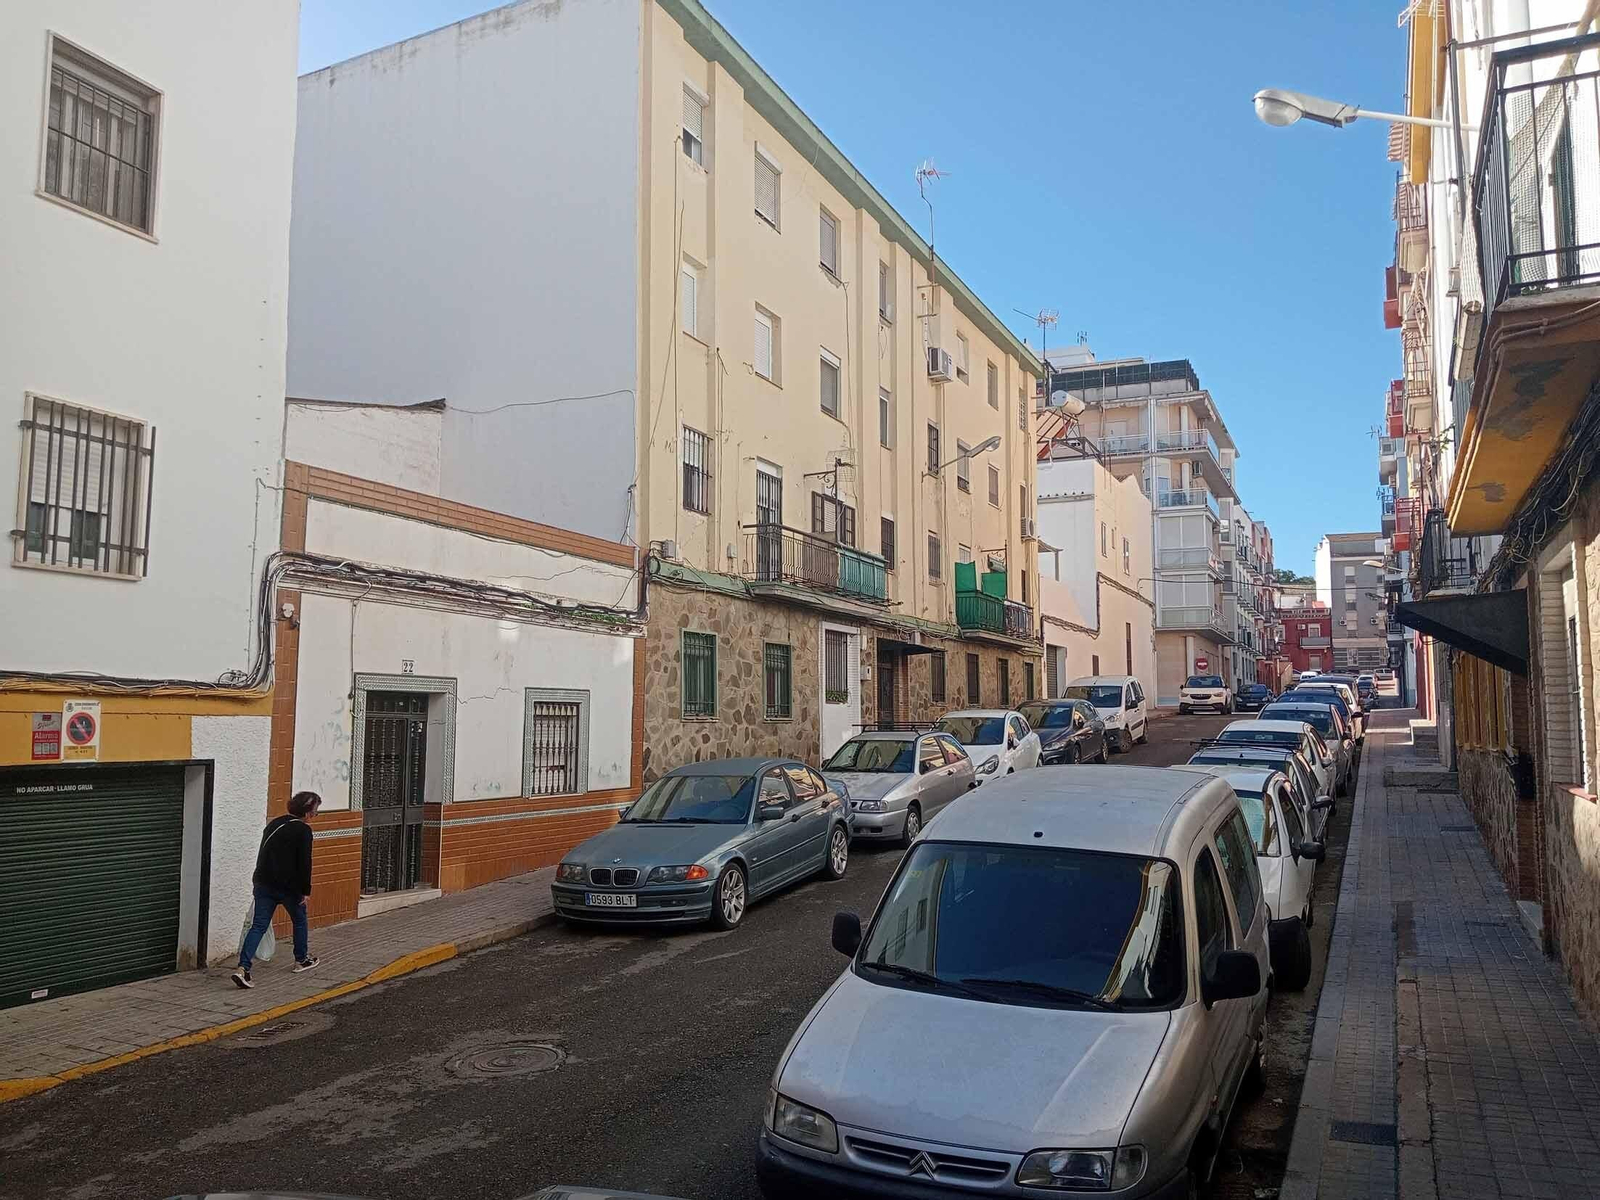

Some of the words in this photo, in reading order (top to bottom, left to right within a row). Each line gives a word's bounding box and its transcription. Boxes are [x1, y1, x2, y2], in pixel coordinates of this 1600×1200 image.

[404, 662, 414, 672] 22
[591, 894, 613, 905] 0593
[616, 896, 634, 906] BLT
